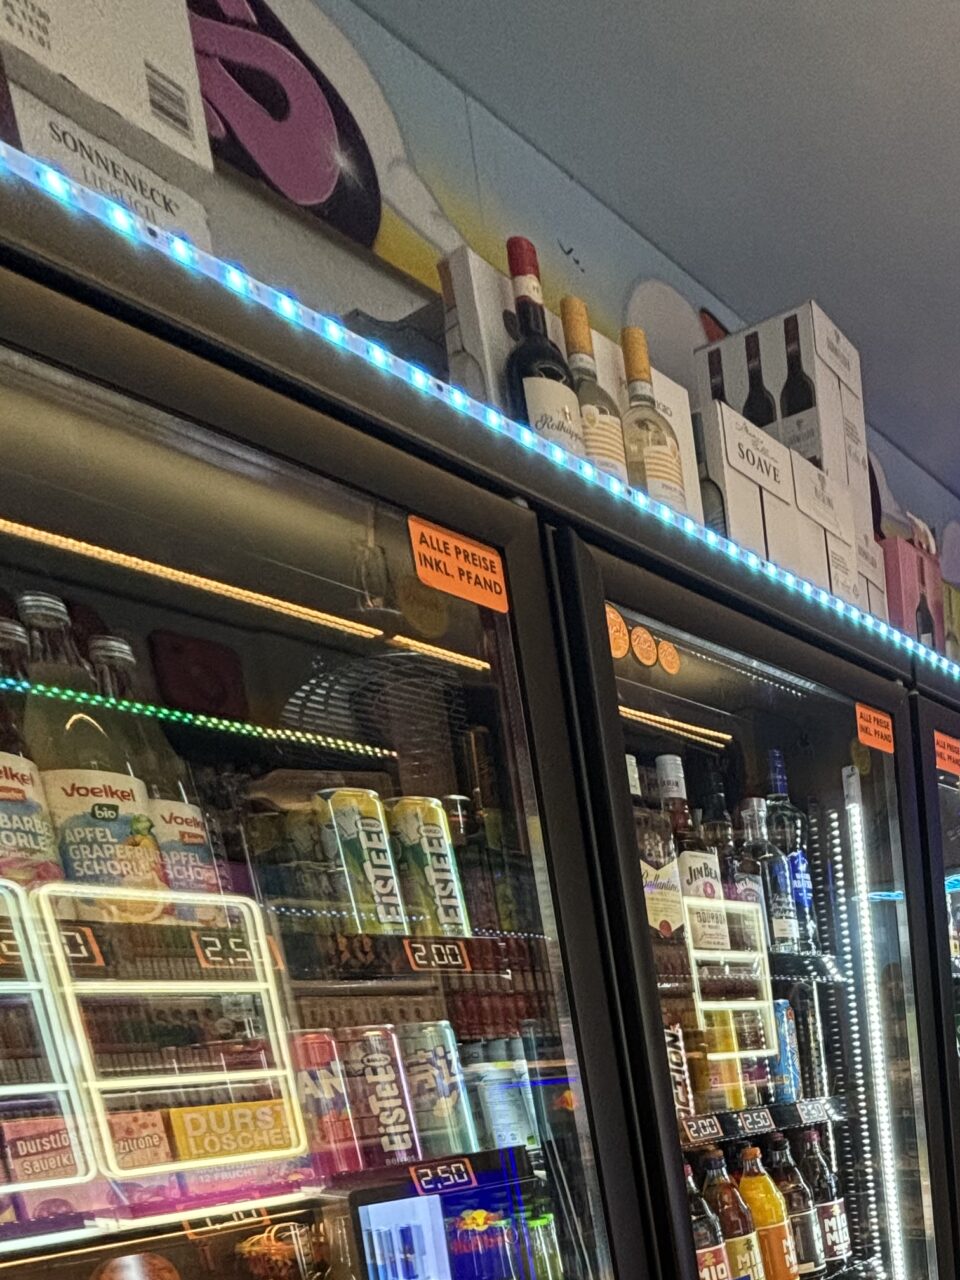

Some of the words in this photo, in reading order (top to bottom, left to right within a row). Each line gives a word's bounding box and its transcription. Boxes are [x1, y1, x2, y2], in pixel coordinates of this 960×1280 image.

[49, 121, 176, 217] SONNENECK
[737, 441, 781, 485] SOAVE
[418, 531, 452, 558] ALLE
[454, 546, 497, 574] PREISE
[418, 553, 455, 580] INKL.
[458, 568, 503, 596] PFAND
[0, 765, 34, 787] elkel
[94, 806, 118, 820] bio
[64, 827, 118, 844] APFEL
[686, 865, 703, 886] JIM
[184, 1105, 290, 1138] DURST
[16, 1129, 72, 1155] Durstlö
